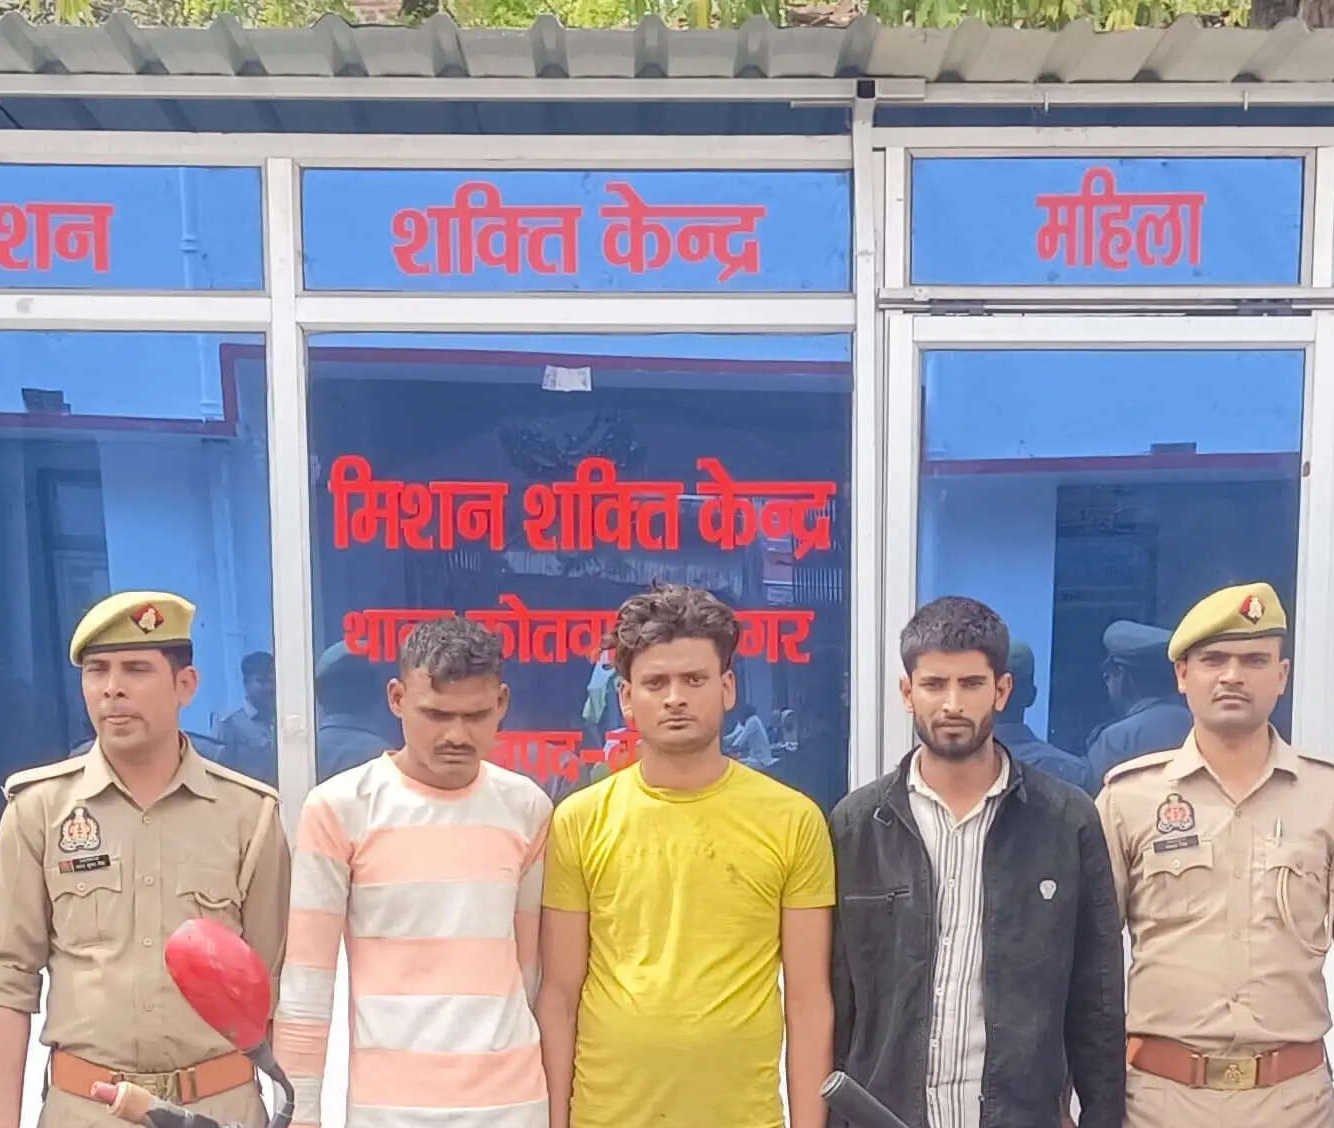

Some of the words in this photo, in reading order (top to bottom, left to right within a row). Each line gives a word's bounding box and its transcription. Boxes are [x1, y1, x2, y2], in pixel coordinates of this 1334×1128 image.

[391, 181, 584, 276] शक्ति
[599, 181, 766, 283] केन्द्र
[1035, 165, 1208, 272] महिला
[327, 454, 510, 551] मिशन
[522, 456, 686, 553] शक्ति
[695, 457, 838, 561] केन्द्र
